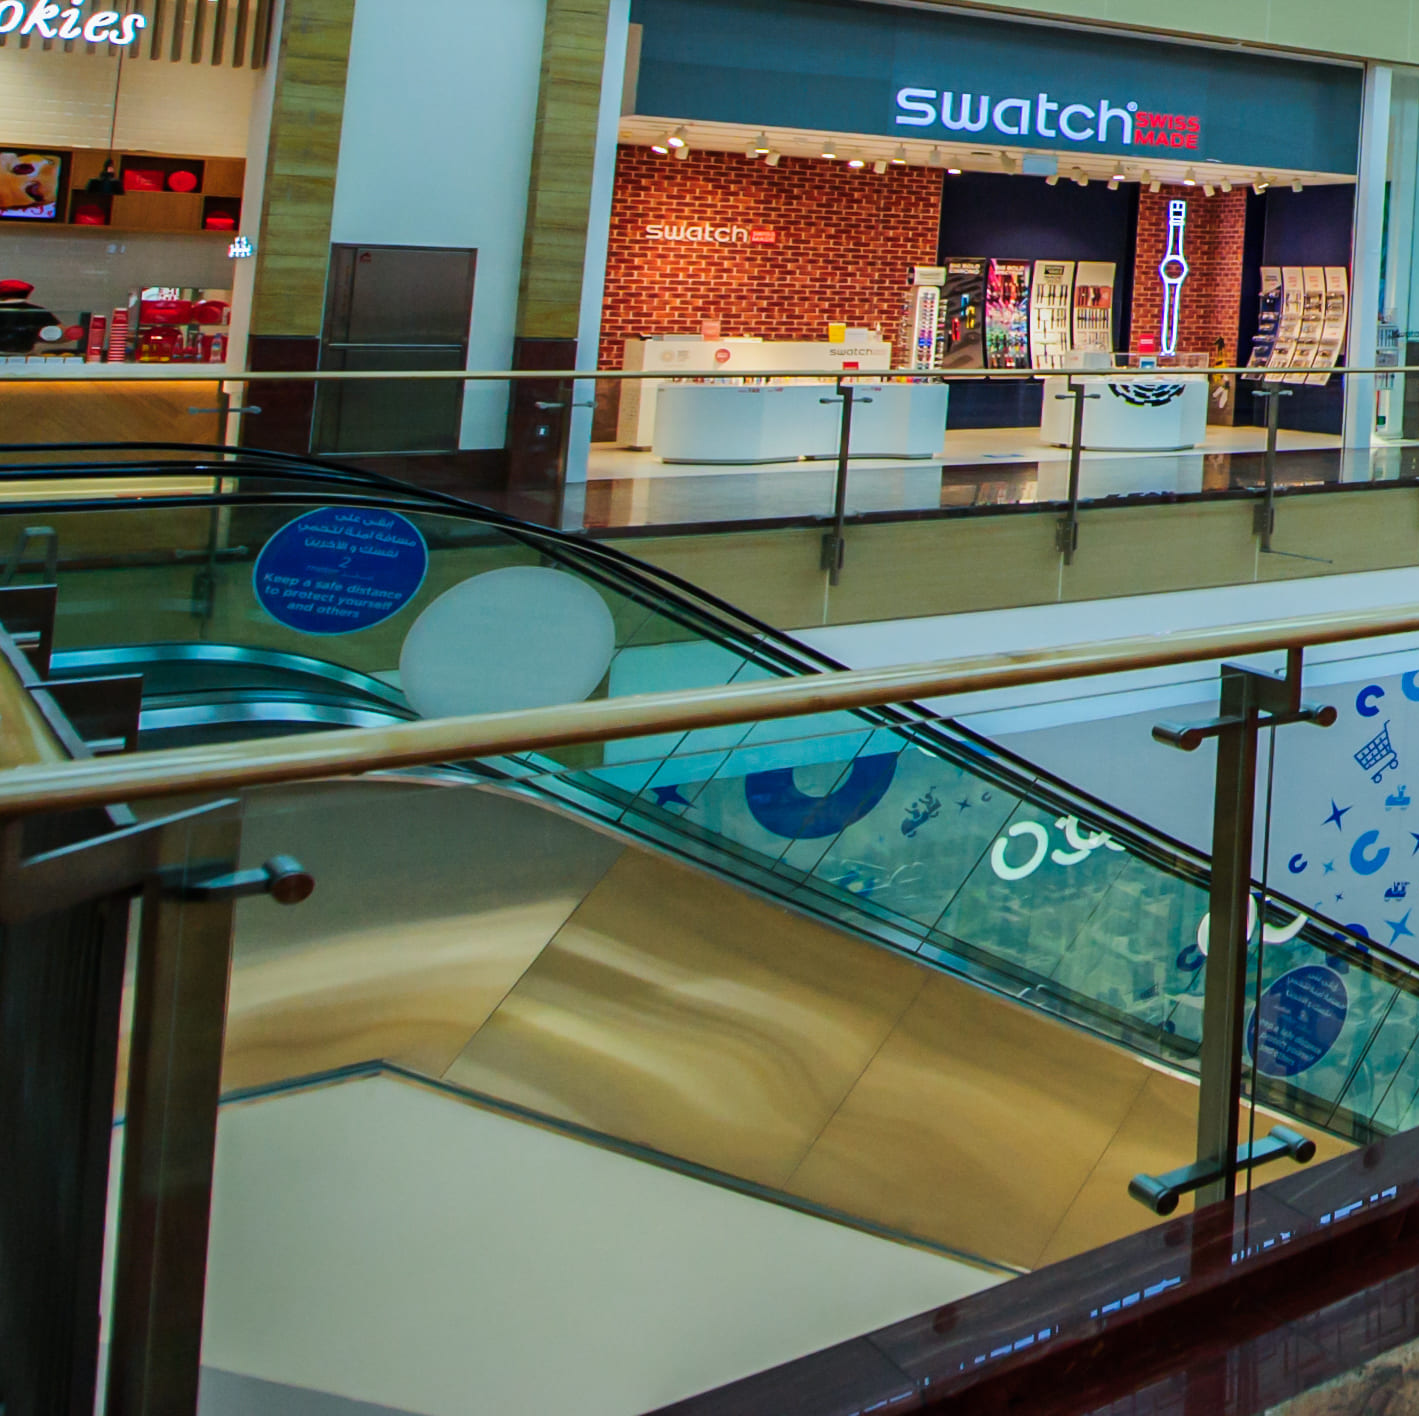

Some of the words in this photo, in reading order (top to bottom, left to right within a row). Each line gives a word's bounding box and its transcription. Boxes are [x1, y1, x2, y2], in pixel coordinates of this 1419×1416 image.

[1135, 111, 1200, 132] SWISS
[1134, 130, 1199, 150] MADE
[645, 223, 748, 243] swatch
[829, 348, 873, 356] swatch
[338, 556, 352, 569] 2
[264, 572, 300, 586] Keep
[302, 579, 312, 587] a
[315, 580, 343, 591] safe
[346, 584, 403, 600] distance
[265, 585, 280, 595] to
[282, 589, 335, 603] protect
[337, 596, 393, 611] yourself
[287, 601, 314, 612] and
[316, 604, 360, 618] others
